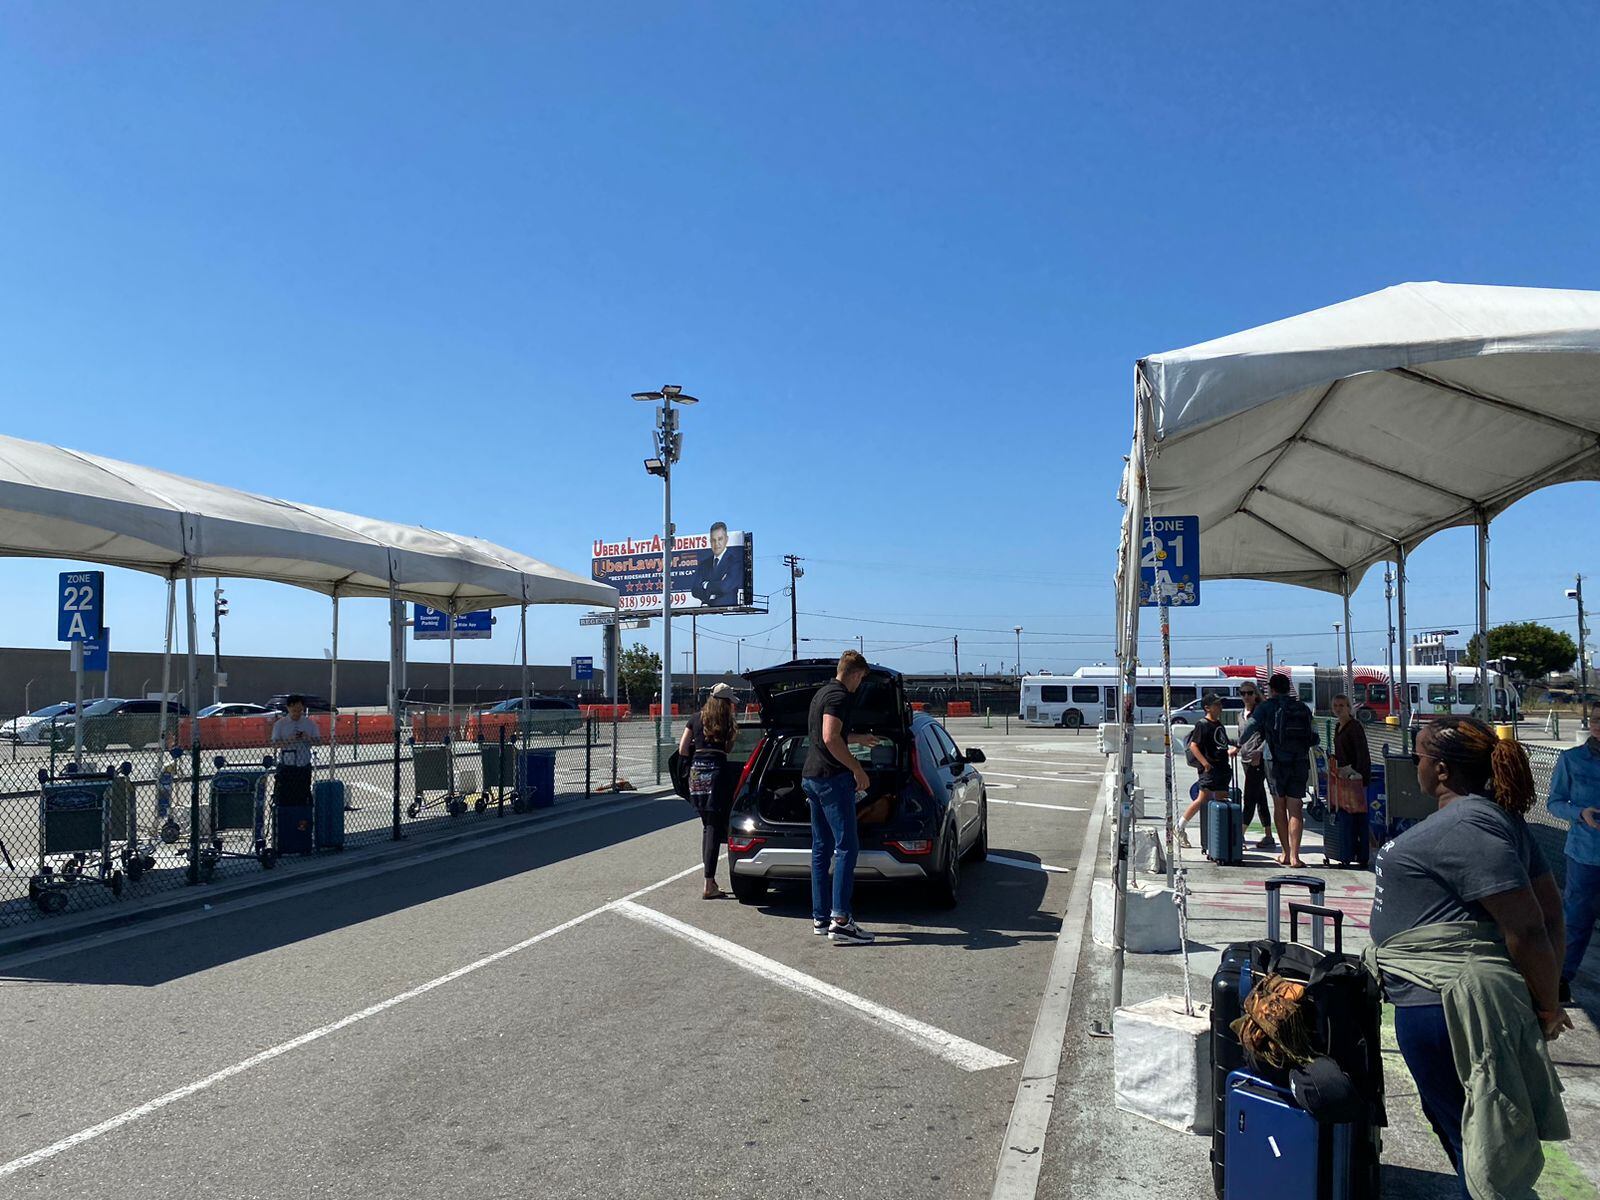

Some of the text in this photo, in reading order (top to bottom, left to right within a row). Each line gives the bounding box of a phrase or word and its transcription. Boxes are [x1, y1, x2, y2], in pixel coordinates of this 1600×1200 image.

[1144, 520, 1185, 531] ZONE
[594, 539, 620, 557] UBER
[627, 537, 652, 555] LYFT
[1141, 535, 1184, 567] 21
[593, 556, 698, 577] UberLawyr.com
[67, 574, 91, 584] ZONE
[64, 586, 94, 611] 22
[67, 612, 87, 638] A
